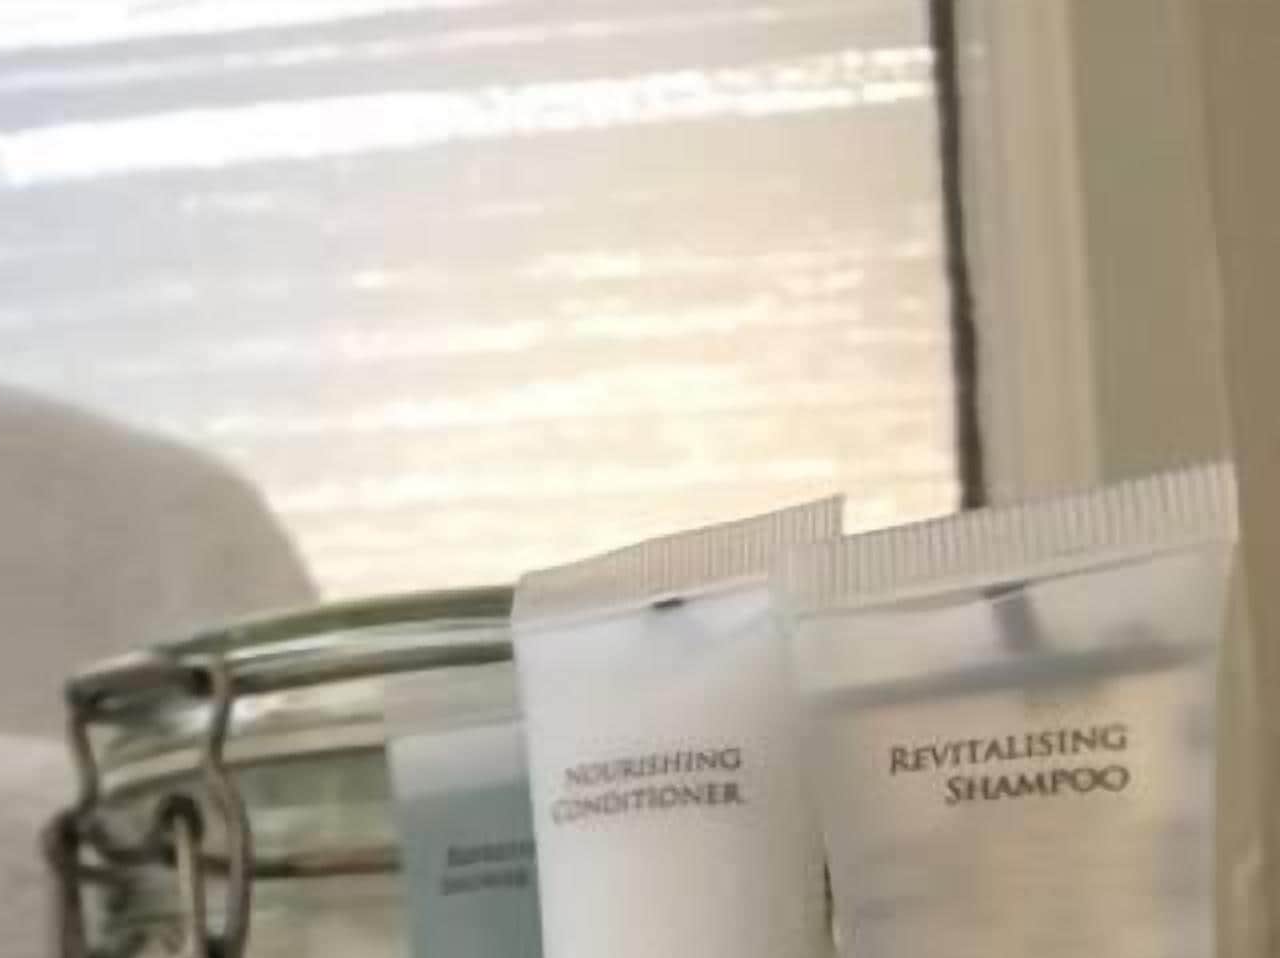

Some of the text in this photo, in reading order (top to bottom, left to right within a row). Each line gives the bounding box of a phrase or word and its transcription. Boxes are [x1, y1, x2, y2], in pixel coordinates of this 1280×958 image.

[565, 747, 742, 787] NOURISHING
[889, 724, 1129, 776] REVITALISING
[551, 783, 745, 825] CONDITIONER
[945, 765, 1131, 805] SHAMPOO
